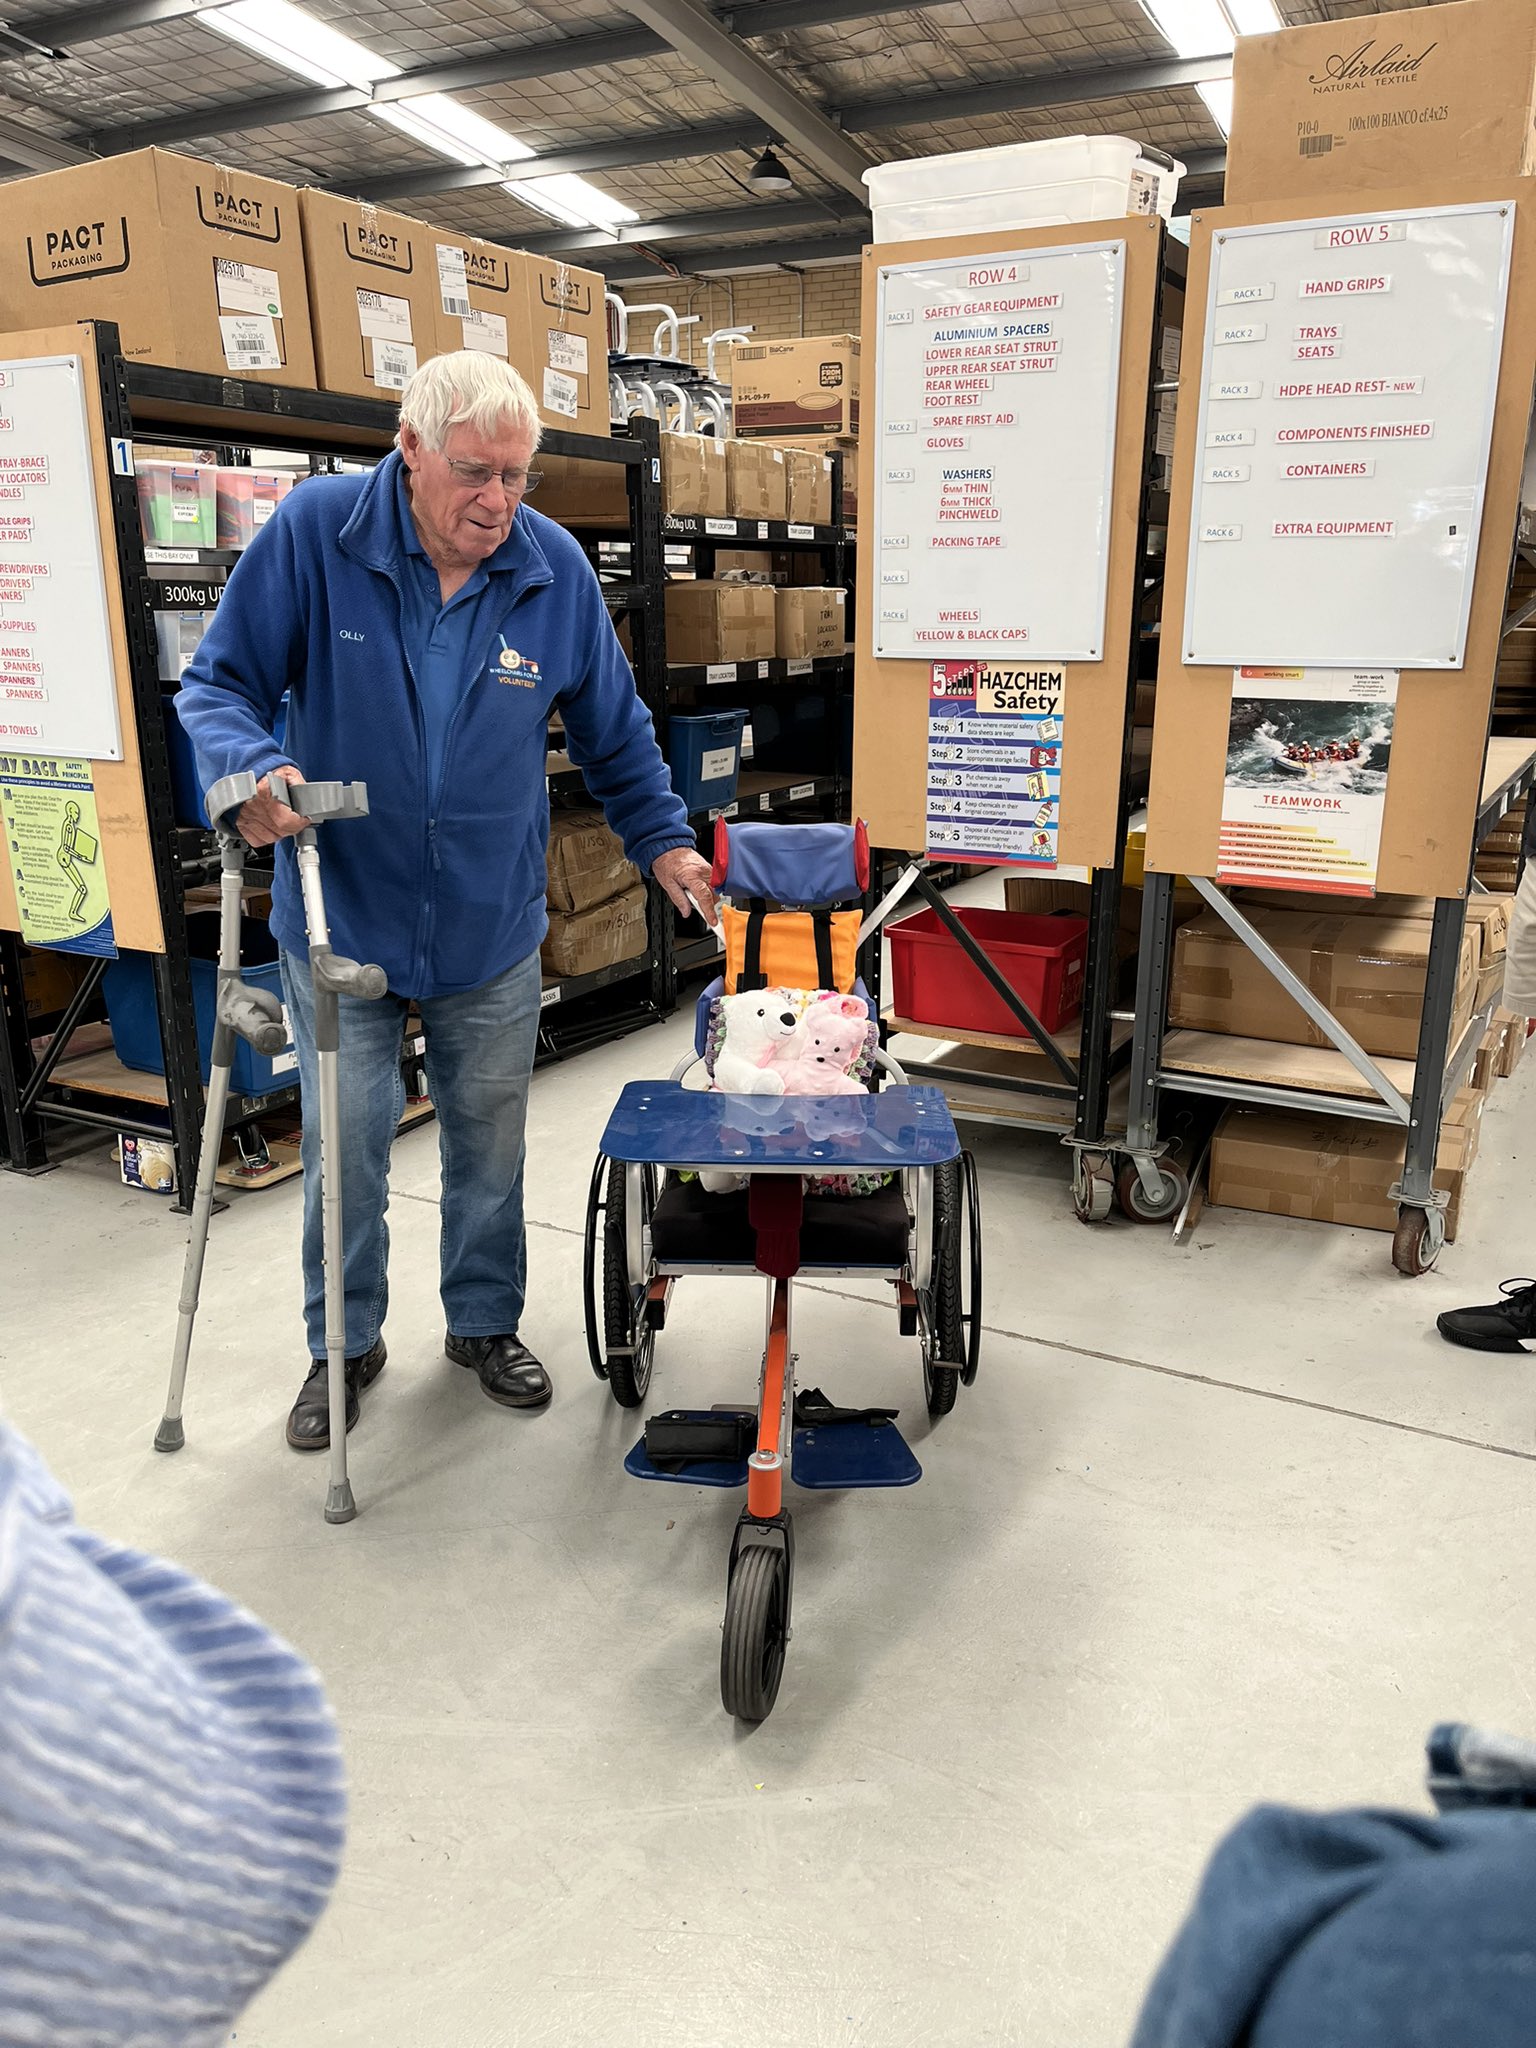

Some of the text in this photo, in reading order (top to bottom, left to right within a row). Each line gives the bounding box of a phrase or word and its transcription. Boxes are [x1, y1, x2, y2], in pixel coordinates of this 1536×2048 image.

[1308, 39, 1438, 84] Airlaid
[1313, 74, 1417, 95] NATURAL TEXTILE
[1298, 120, 1319, 136] P10-0
[1348, 114, 1380, 132] 100x100
[1382, 109, 1417, 127] BIANCO
[214, 192, 262, 218] PACT
[218, 213, 260, 229] PACKAGING
[47, 222, 104, 256] PACT
[358, 227, 398, 252] PACT
[1330, 226, 1389, 246] ROW 5
[361, 247, 396, 262] PACKAGING
[52, 252, 102, 270] PACKAGING
[463, 251, 496, 272] PACT
[969, 267, 1016, 286] ROW 4
[1305, 277, 1384, 294] HAND GRIPS
[358, 291, 381, 307] 3025170
[1234, 290, 1255, 298] RACK
[925, 296, 1059, 319] SAFETY GEAR EQUIPMENT
[934, 324, 1049, 341] ALUMINIUM SPACERS
[1225, 329, 1252, 339] RACK 2
[1299, 326, 1337, 338] TRAYS
[926, 341, 1057, 360] LOWER REAR SEAT STRUT
[1298, 346, 1334, 358] SEATS
[926, 358, 1054, 376] UPPER REAR SEAT STRUT
[926, 379, 989, 390] REAR WHEEL
[1221, 386, 1241, 394] RACK
[1280, 384, 1312, 396] HDPE
[1316, 382, 1351, 394] HEAD
[1394, 382, 1415, 390] NEW
[925, 395, 978, 406] FOOT REST
[933, 414, 1013, 426] SPARE FIRST AID
[1238, 433, 1242, 441] 4
[1278, 424, 1430, 441] COMPONENTS FINISHED
[927, 438, 963, 447] GLOVES
[117, 442, 128, 472] 1
[652, 461, 658, 481] 2
[943, 469, 992, 479] WASHERS
[1212, 470, 1233, 478] RACK
[1287, 463, 1366, 476] CONTAINERS
[7, 473, 46, 483] LOCATORS
[943, 484, 988, 494] 6MM THIN
[940, 496, 991, 506] 6MM THICK
[939, 509, 998, 519] PINCHWELD
[12, 517, 31, 525] GRIPS
[665, 519, 697, 532] 300kg UDL
[1274, 522, 1393, 534] EXTRA EQUIPMENT
[8, 531, 28, 540] PADS
[932, 537, 1000, 546] PACKING TAPE
[179, 552, 193, 560] ONLY
[0, 579, 31, 588] DRIVERS
[165, 586, 205, 605] 300kg
[939, 611, 978, 621] WHEELS
[3, 620, 35, 631] SUPPLIES
[340, 630, 364, 642] OLLY
[916, 629, 1027, 640] YELLOW & BLACK CAPS
[3, 661, 41, 672] SPANNERS
[0, 676, 35, 685] SPANNERS
[498, 676, 535, 688] VOLUNTEER
[933, 665, 974, 696] 5 STEPS
[980, 672, 1061, 691] HAZCHEM
[6, 689, 43, 699] SPANNERS
[994, 691, 1058, 715] Safety
[9, 726, 38, 735] TOWELS
[933, 722, 963, 732] Step 1
[932, 748, 963, 759] Step 2
[0, 757, 59, 777] MY BACK
[931, 775, 962, 785] Step 3
[930, 802, 961, 812] Step 4
[1264, 795, 1341, 808] TEAMWORK
[929, 830, 959, 840] Step 5
